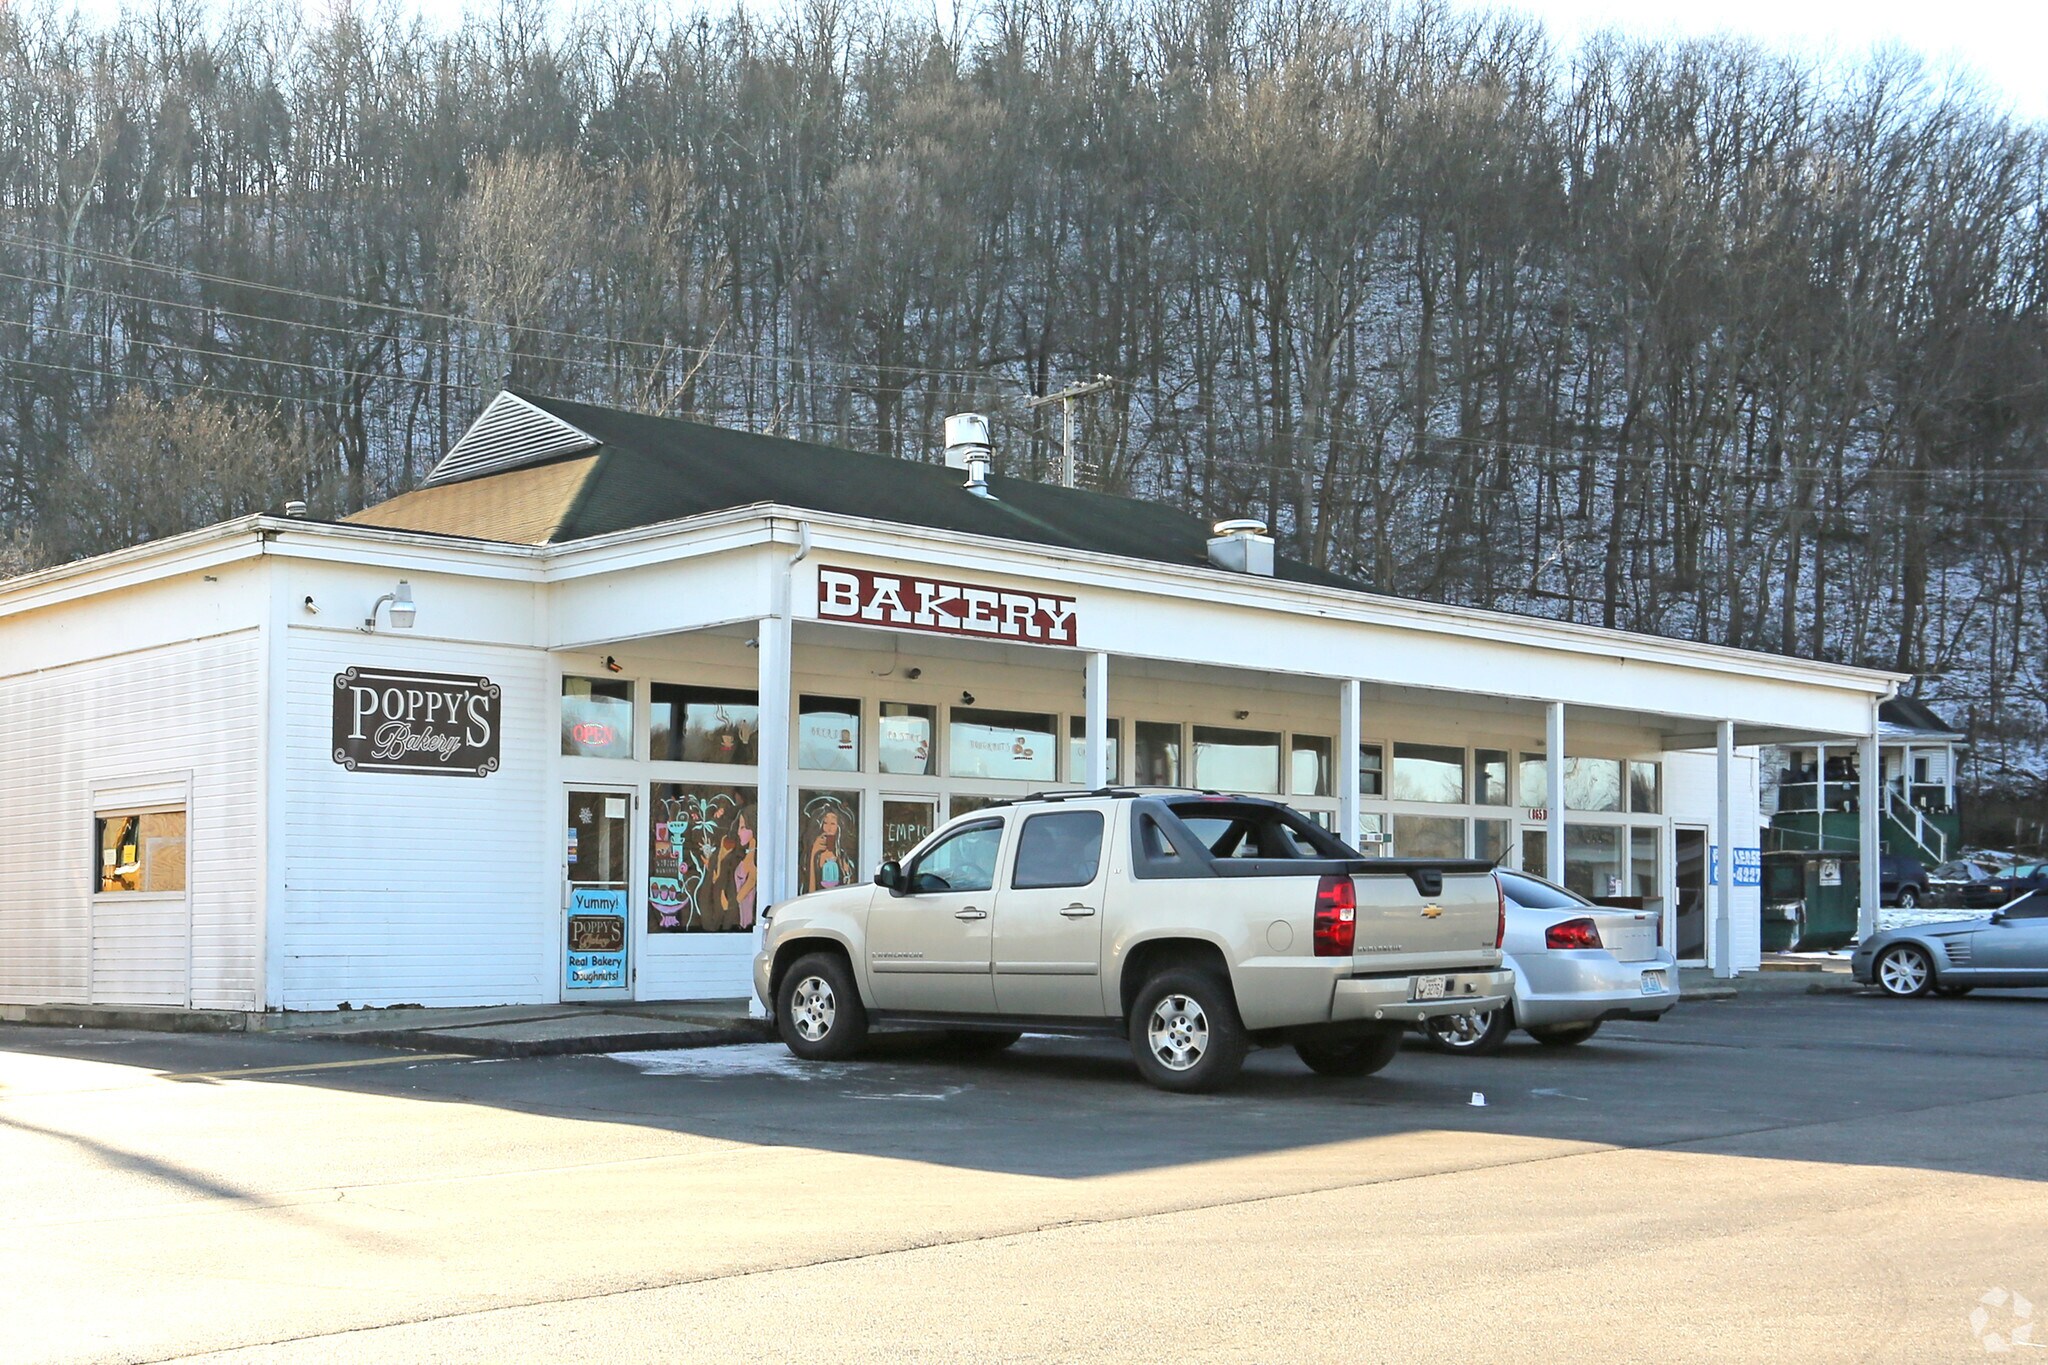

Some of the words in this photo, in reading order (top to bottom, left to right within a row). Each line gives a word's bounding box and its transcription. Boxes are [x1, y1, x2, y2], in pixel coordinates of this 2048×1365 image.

[820, 570, 1076, 640] BAKERY
[347, 686, 491, 748] POPPY'S
[371, 721, 461, 761] Bakery
[573, 724, 613, 744] OPEN
[576, 895, 619, 912] Yummy!
[572, 921, 621, 941] POPPY'S
[569, 956, 588, 966] Real
[592, 956, 622, 968] Bakery
[572, 971, 619, 984] Doughnuts!
